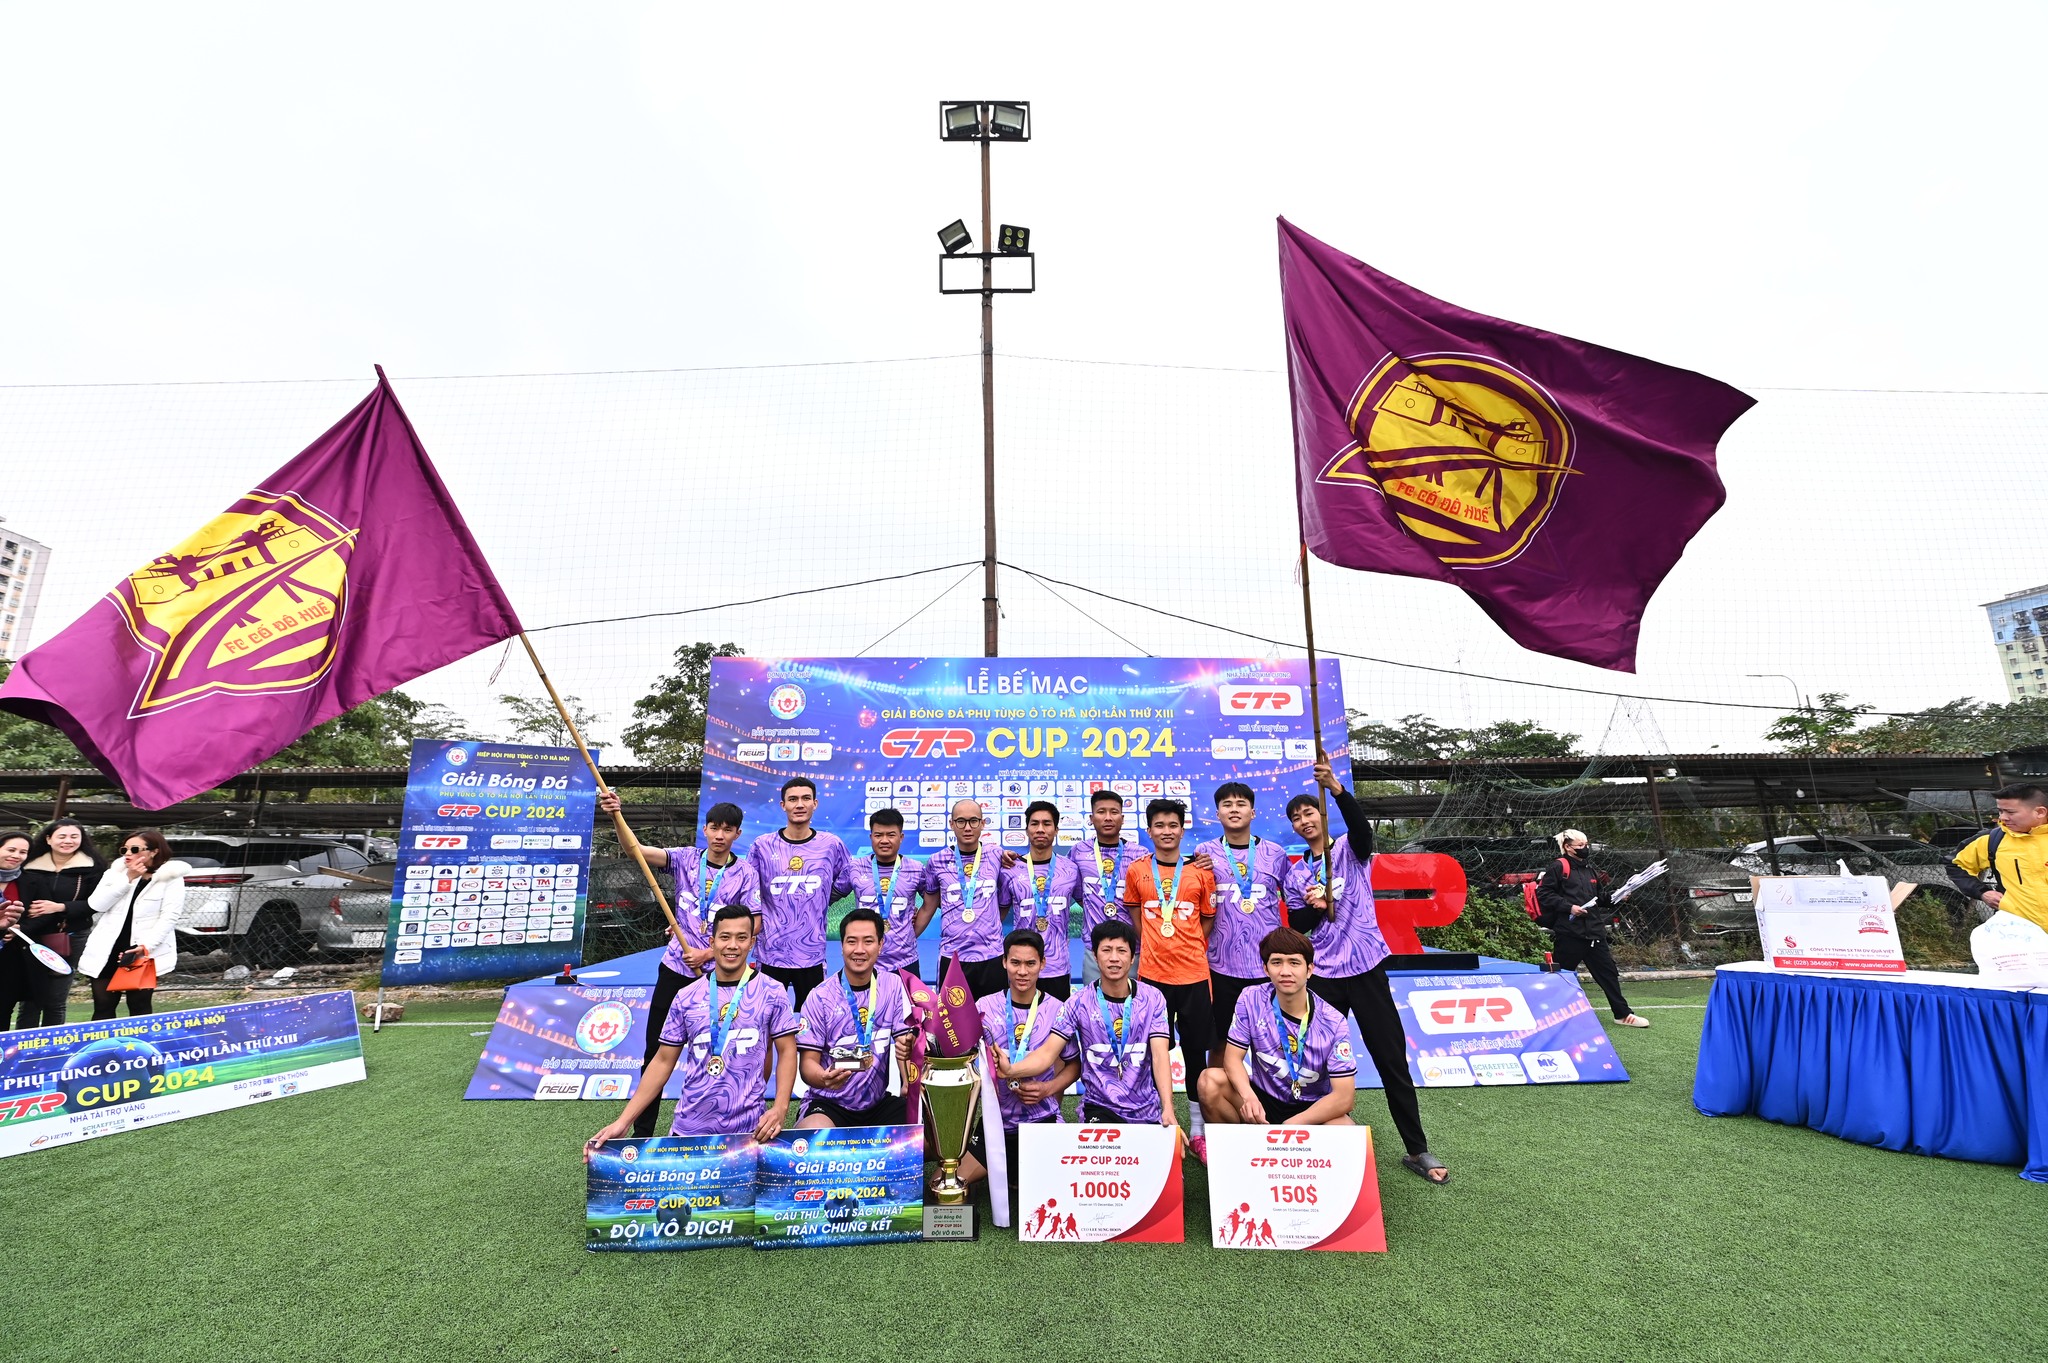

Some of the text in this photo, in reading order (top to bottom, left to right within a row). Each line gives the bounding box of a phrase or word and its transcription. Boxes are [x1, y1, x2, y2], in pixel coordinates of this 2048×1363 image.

[1396, 481, 1491, 524] FC CỐ ĐÔ HUẾ
[224, 598, 331, 654] FC CỐ ĐÔ HUẾ
[967, 667, 1088, 700] LỄ BẾ MẠC
[882, 705, 1174, 721] GIẢI BÓNG ĐÁ PHỤ TÙNG Ô TÔ HÀ NỘI LẦN THỨ XIII
[986, 728, 1068, 758] CUP
[1082, 727, 1176, 758] 2024
[442, 770, 568, 791] Giải Bóng Đá
[485, 806, 522, 818] CUP
[526, 806, 565, 818] 2024
[1430, 998, 1512, 1024] CTR
[18, 1014, 225, 1050] HIỆP HỘI PHỤ TÙNG Ô TÔ HÀ NỘI
[4, 1033, 298, 1090] PHỤ TÙNG Ô TÔ HÀ NỘI LẦN THỨ XIII
[1537, 1059, 1558, 1067] MK
[76, 1079, 141, 1107] CUP
[150, 1066, 215, 1094] 2024
[70, 1103, 146, 1124] NHÀ TÀI TRỢ VÀNG
[82, 1119, 125, 1131] SCHAEFFLER
[795, 1157, 886, 1174] Giải Bóng Đá
[1091, 1156, 1112, 1165] CUP
[1115, 1157, 1139, 1165] 2024
[1282, 1158, 1303, 1168] CUP
[1306, 1159, 1332, 1168] 2024
[625, 1166, 721, 1185] Giải Bóng Đá
[827, 1189, 853, 1200] CUP
[857, 1187, 885, 1198] 2024
[1070, 1180, 1131, 1200] 1.000$
[1270, 1184, 1318, 1205] 150$
[659, 1198, 686, 1209] CUP
[690, 1196, 721, 1208] 2024
[774, 1204, 904, 1222] CẦU THỦ XUẤT SẮC NHẤT
[610, 1218, 733, 1242] ĐỘI VÔ ĐỊCH
[786, 1216, 892, 1237] TRẬN CHUNG KẾT
